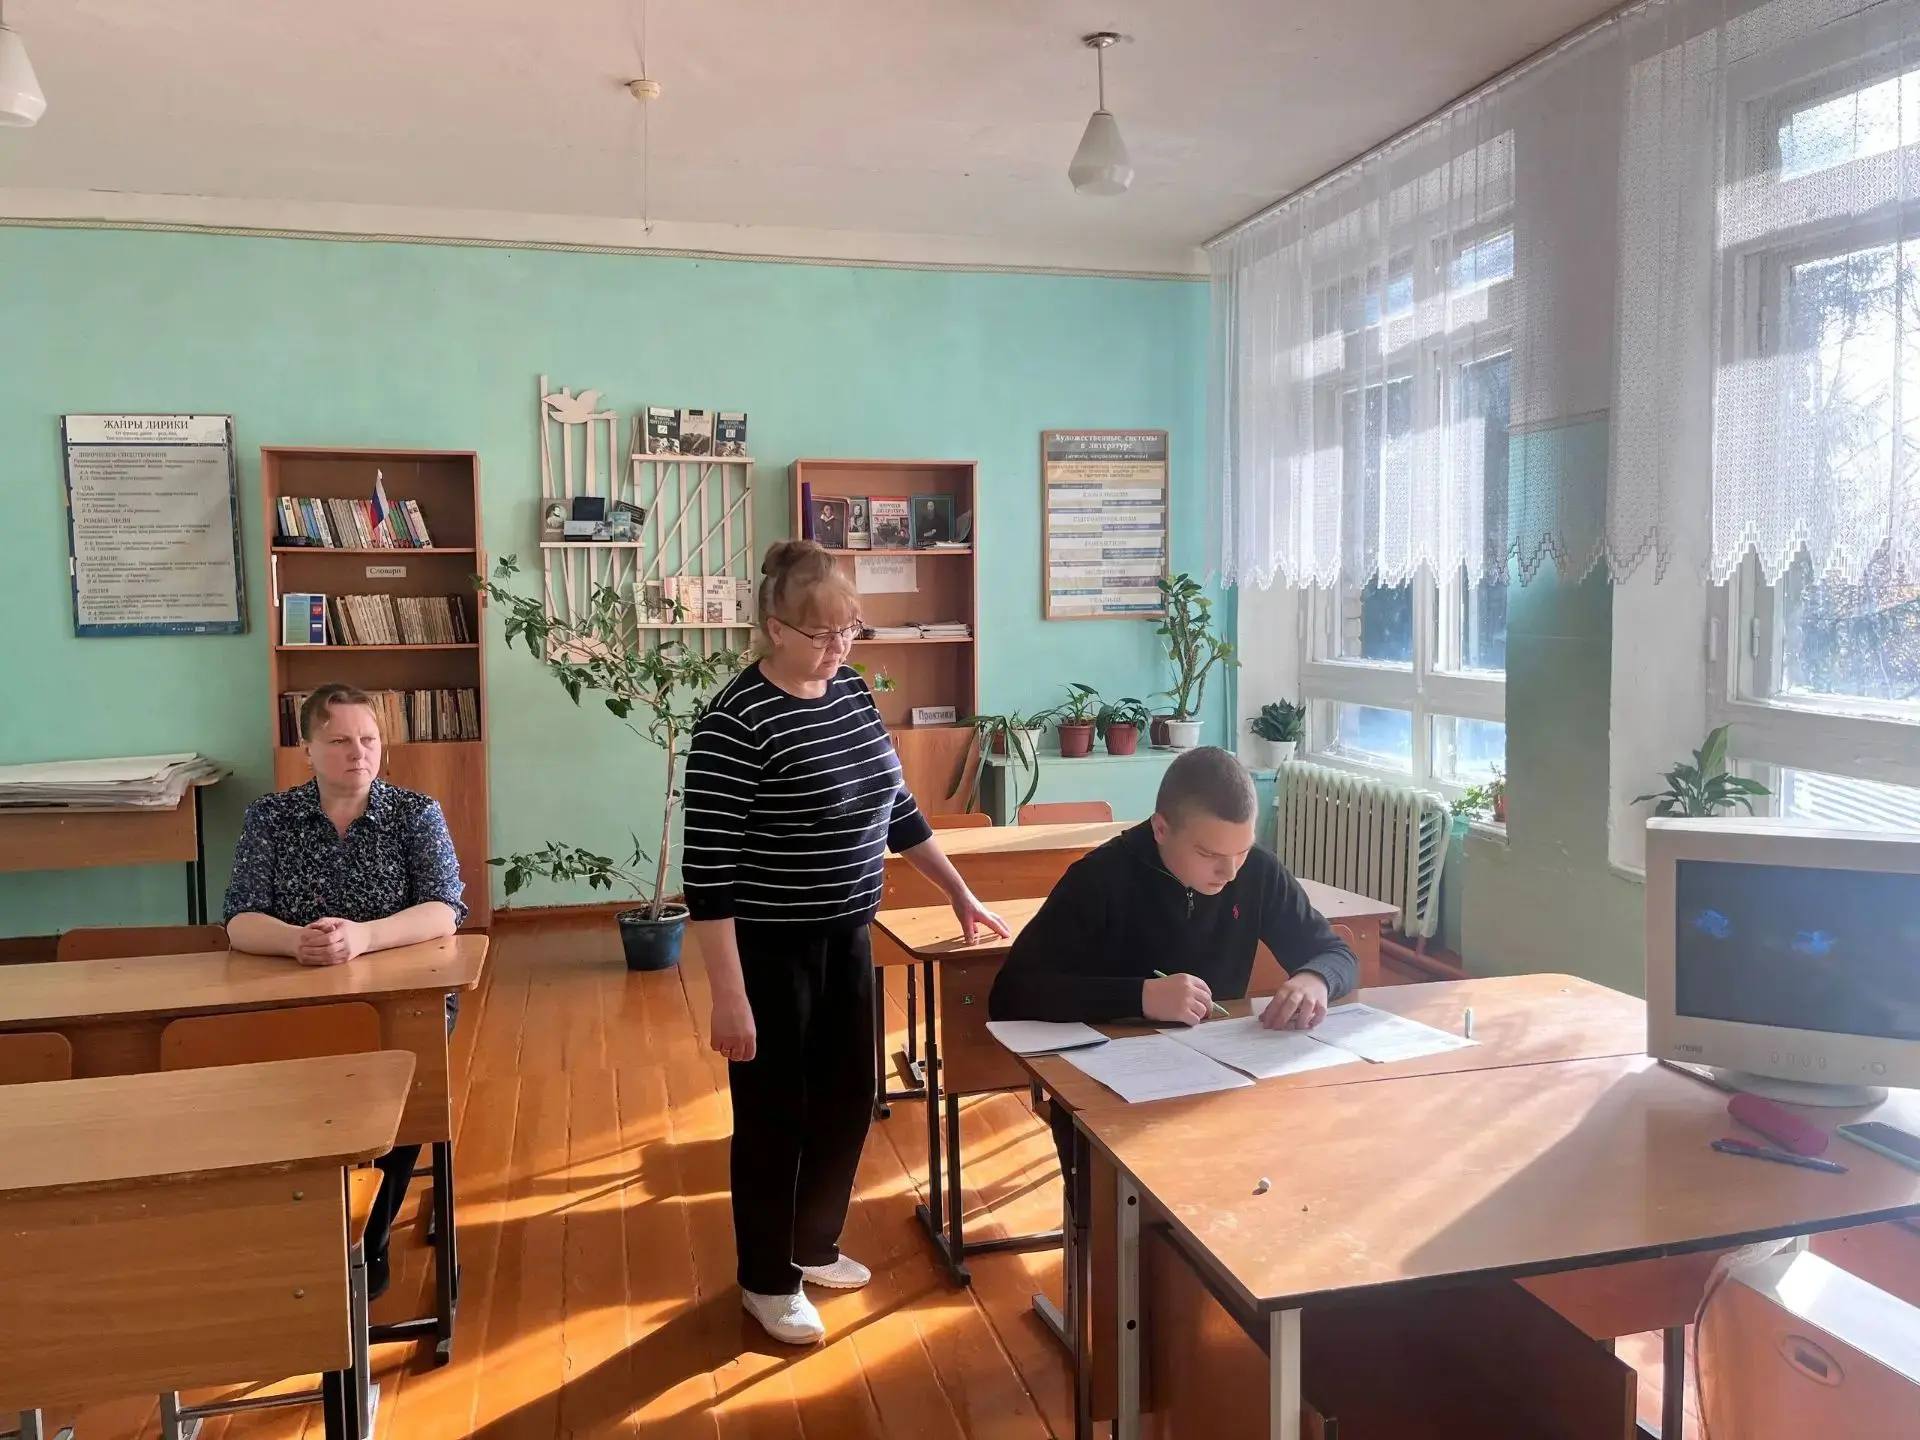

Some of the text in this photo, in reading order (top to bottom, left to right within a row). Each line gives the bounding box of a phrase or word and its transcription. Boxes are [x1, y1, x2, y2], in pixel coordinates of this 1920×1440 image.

[104, 420, 189, 430] ЖАНРЫ ЛИРИКИ
[1055, 434, 1158, 444] Художественные системы
[1088, 443, 1133, 451] литературе
[370, 567, 401, 576] Словари
